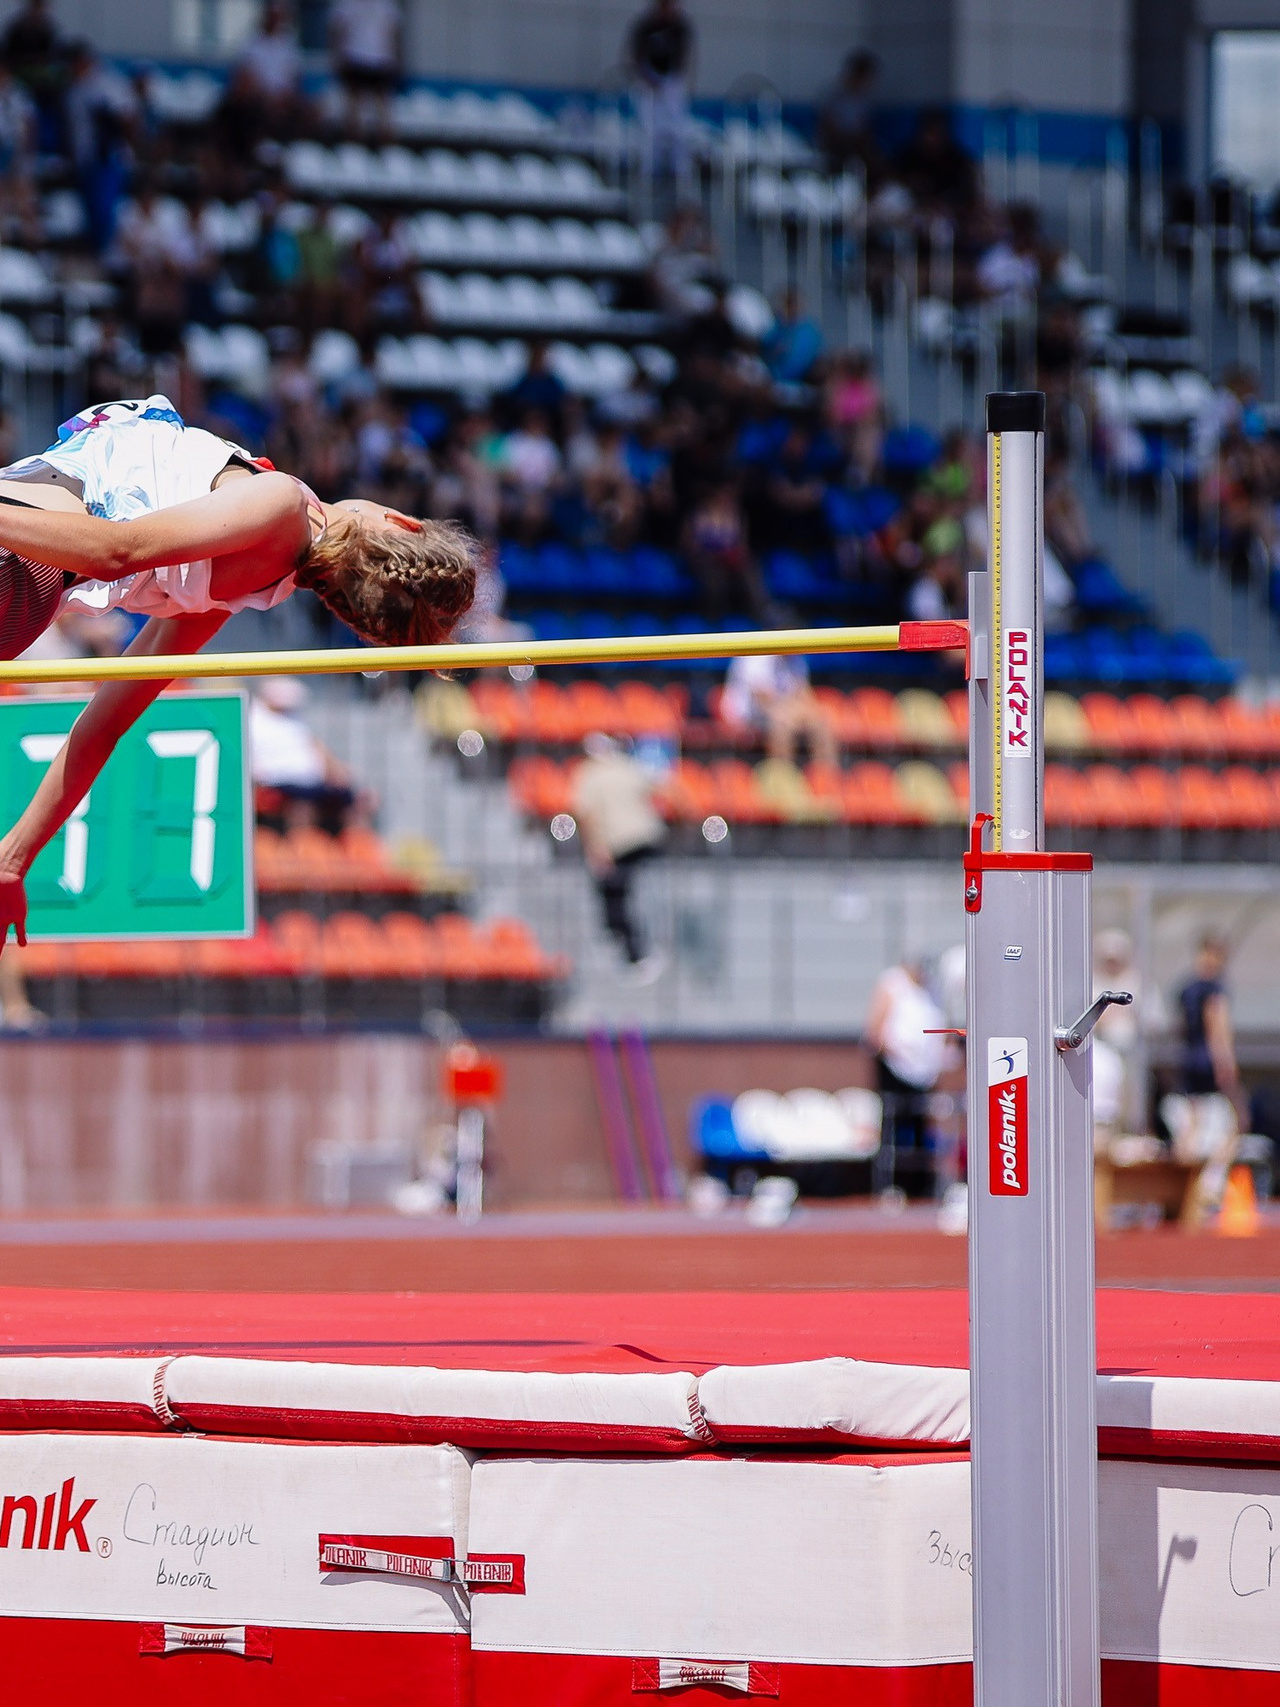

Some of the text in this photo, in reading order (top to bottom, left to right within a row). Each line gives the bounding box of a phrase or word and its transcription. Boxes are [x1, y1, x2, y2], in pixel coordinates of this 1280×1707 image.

[1006, 631, 1030, 747] POLANIK
[998, 1089, 1021, 1189] polanik
[386, 1553, 433, 1577] POLANIK
